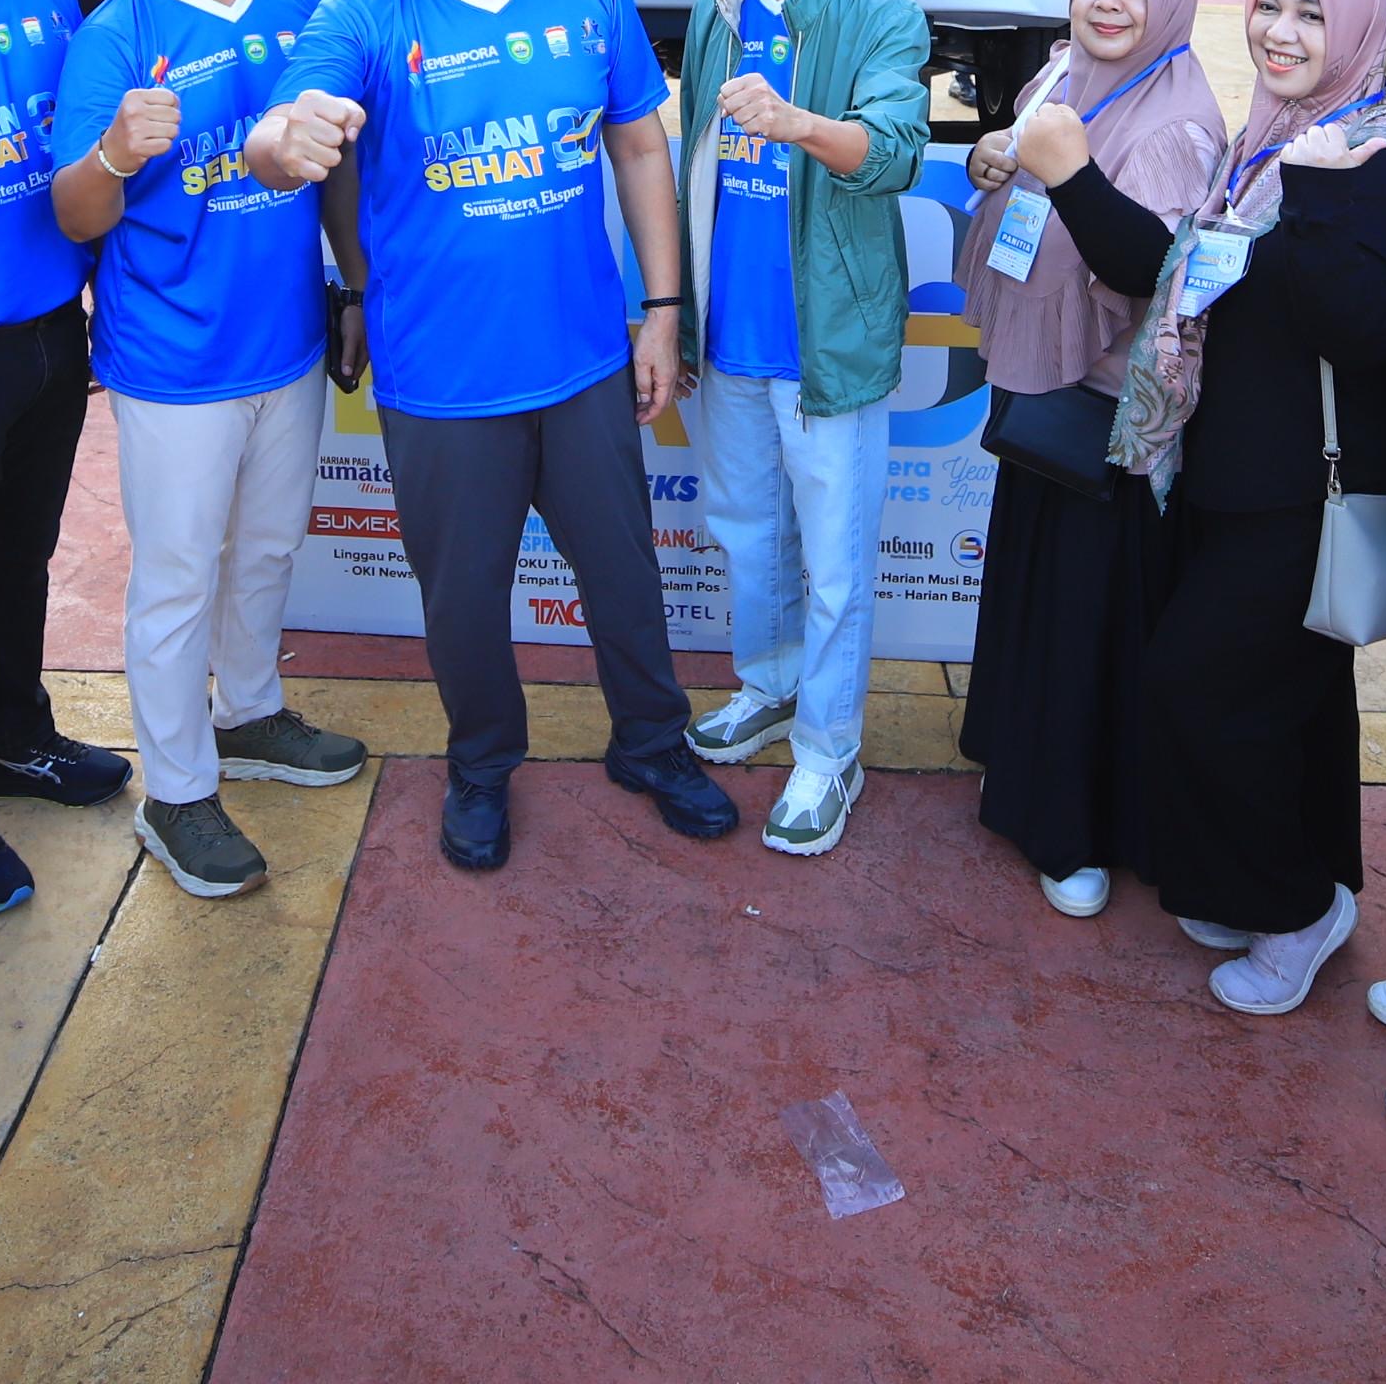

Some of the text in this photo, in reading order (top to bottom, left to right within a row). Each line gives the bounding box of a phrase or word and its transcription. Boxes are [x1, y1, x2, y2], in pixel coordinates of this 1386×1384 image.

[167, 48, 237, 82] KEMENPORA
[423, 115, 539, 165] JALAN
[182, 152, 249, 196] SEH
[424, 146, 545, 192] SEHAT
[207, 190, 270, 214] Sumatera
[463, 184, 584, 218] Sumatera Ekspres
[1001, 233, 1032, 253] PANITIA
[320, 456, 370, 466] HARIAN PAGI
[316, 464, 393, 482] umate
[358, 483, 394, 495] Utam
[316, 514, 400, 533] SUMEK
[652, 529, 695, 548] BANG
[333, 549, 384, 562] Linggau
[877, 536, 934, 559] mbang
[518, 558, 548, 569] OKU
[659, 565, 701, 576] umulih
[352, 566, 375, 576] OKI
[379, 568, 414, 579] News
[519, 575, 560, 587] Empat
[882, 572, 924, 584] Harian
[929, 573, 959, 585] Musi
[661, 582, 693, 592] alam
[697, 582, 720, 592] Pos
[905, 590, 948, 601] Harian
[663, 604, 716, 620] OTEL
